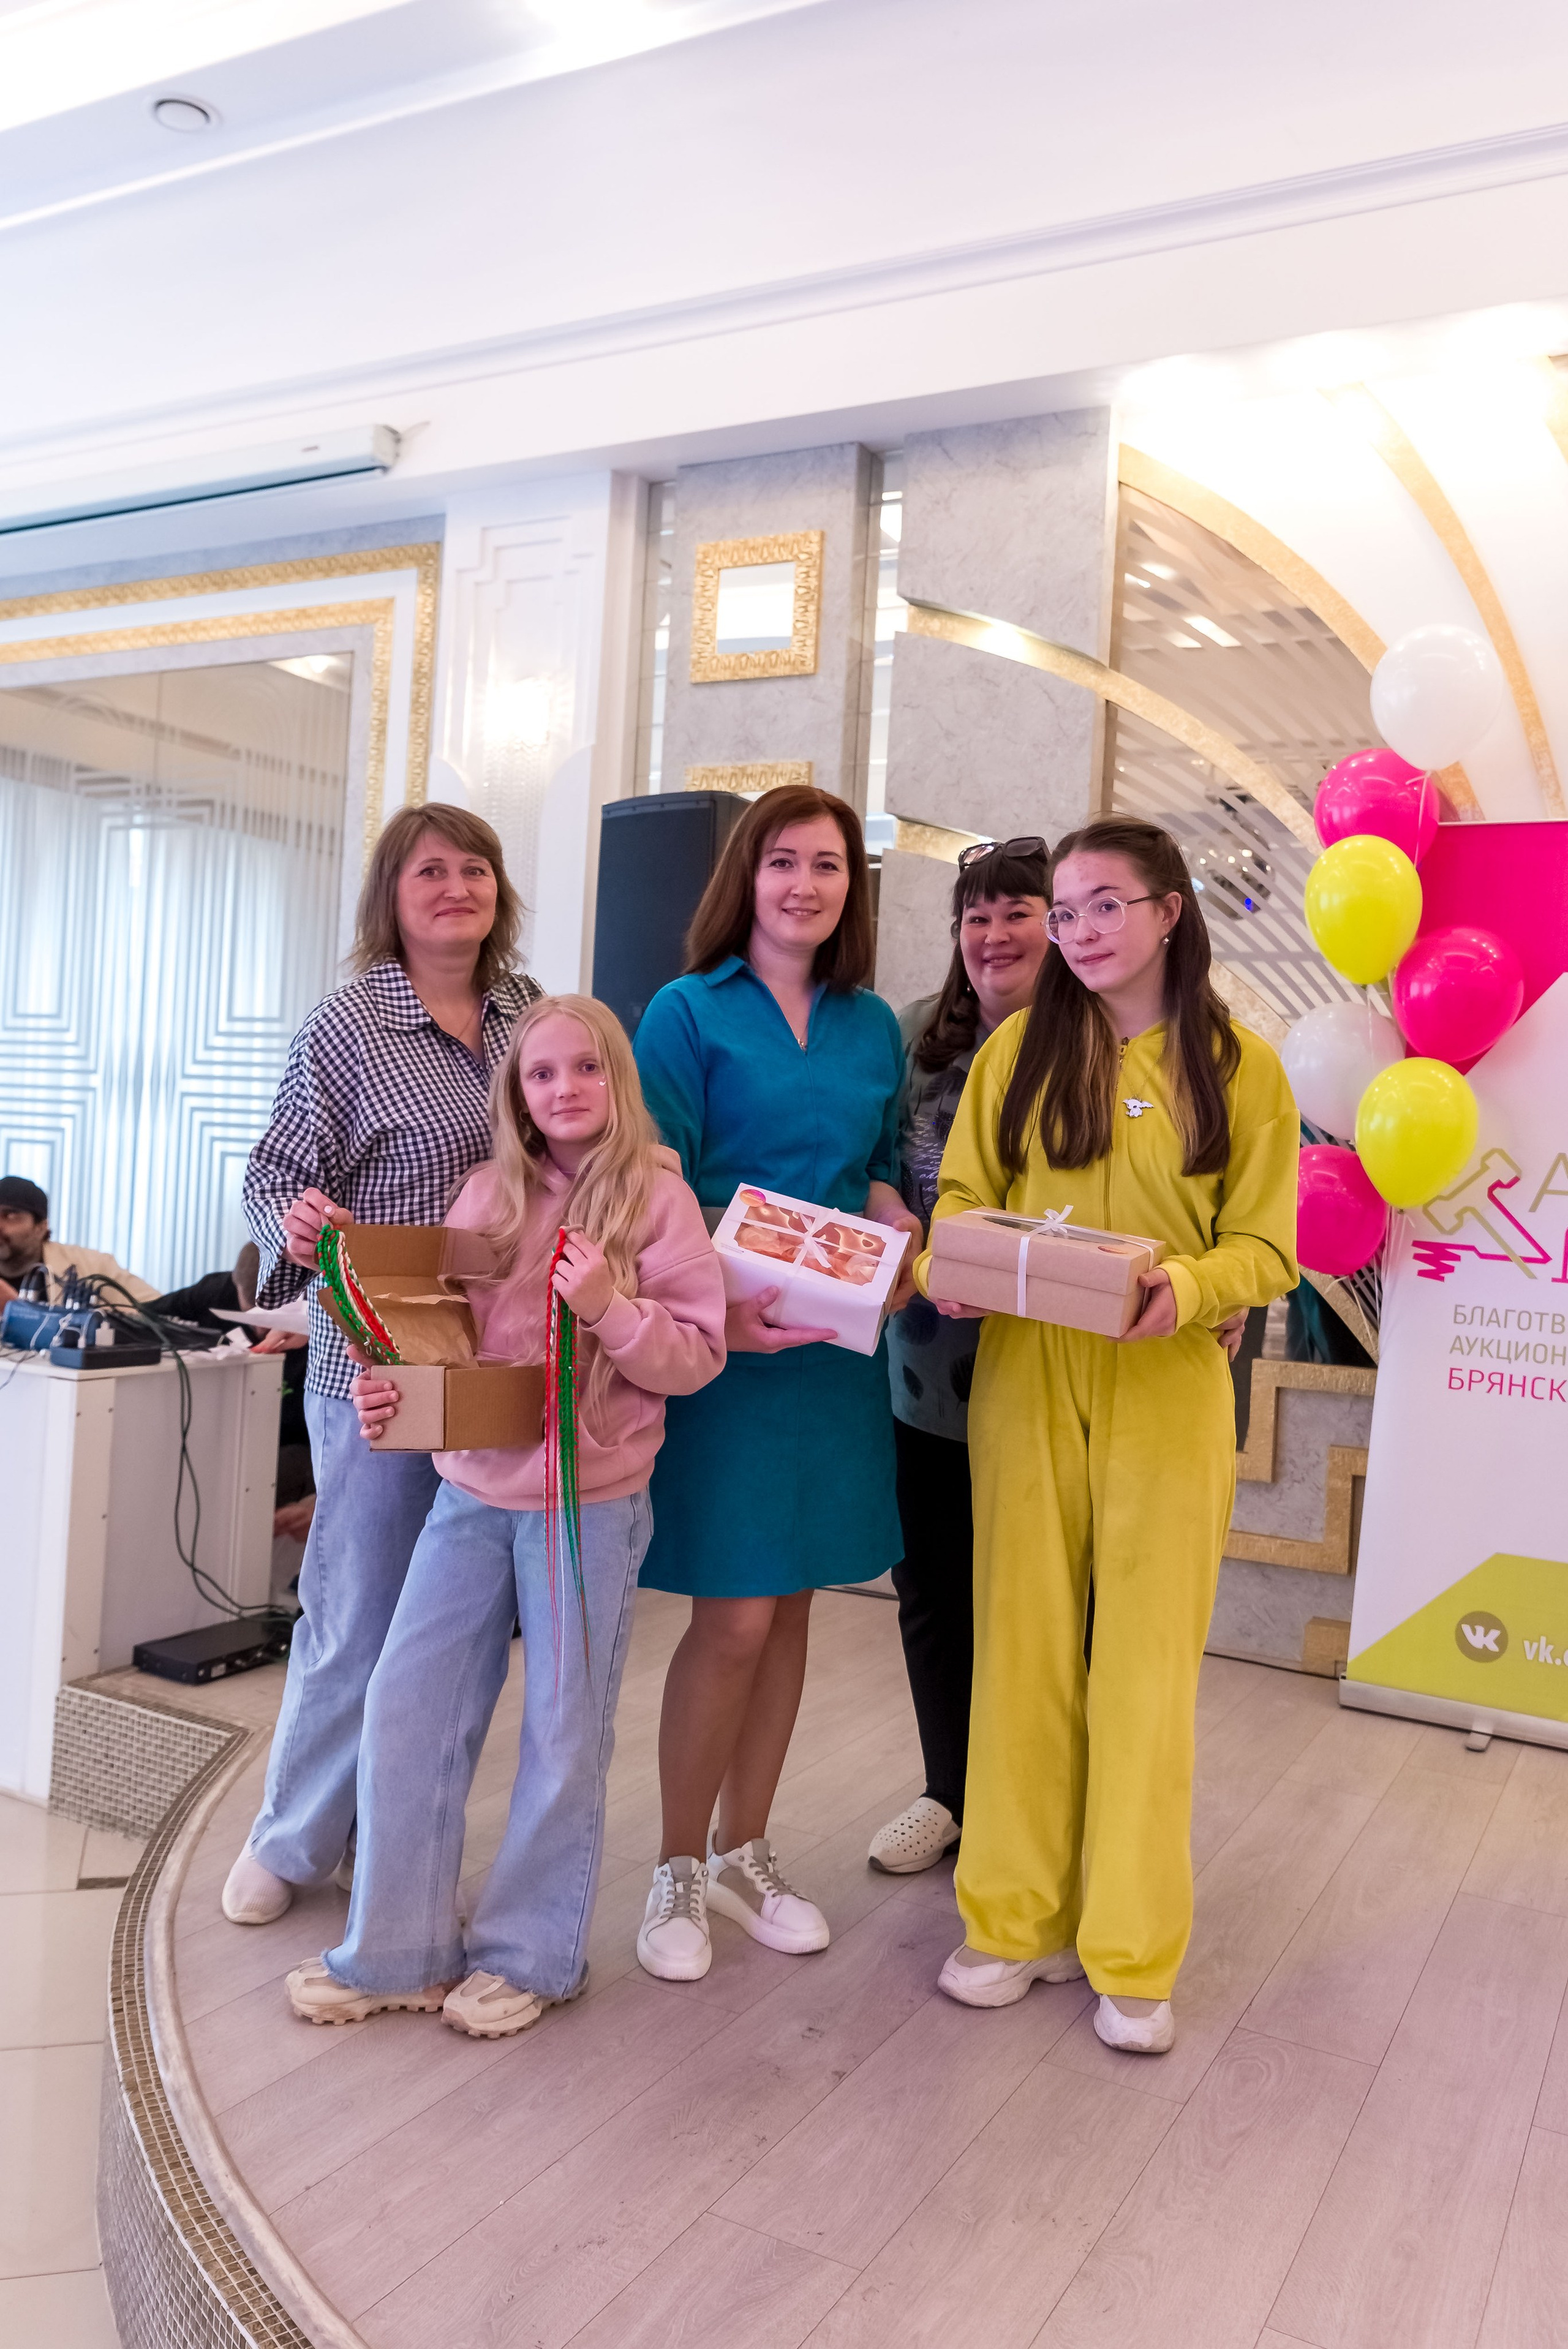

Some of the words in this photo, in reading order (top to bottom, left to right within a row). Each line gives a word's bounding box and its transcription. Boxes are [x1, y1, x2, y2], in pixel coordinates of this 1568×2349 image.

[1453, 1304, 1566, 1334] БЛАГОТВ
[1449, 1335, 1567, 1366] АУКЦИОН
[1448, 1367, 1567, 1403] БРЯНСК
